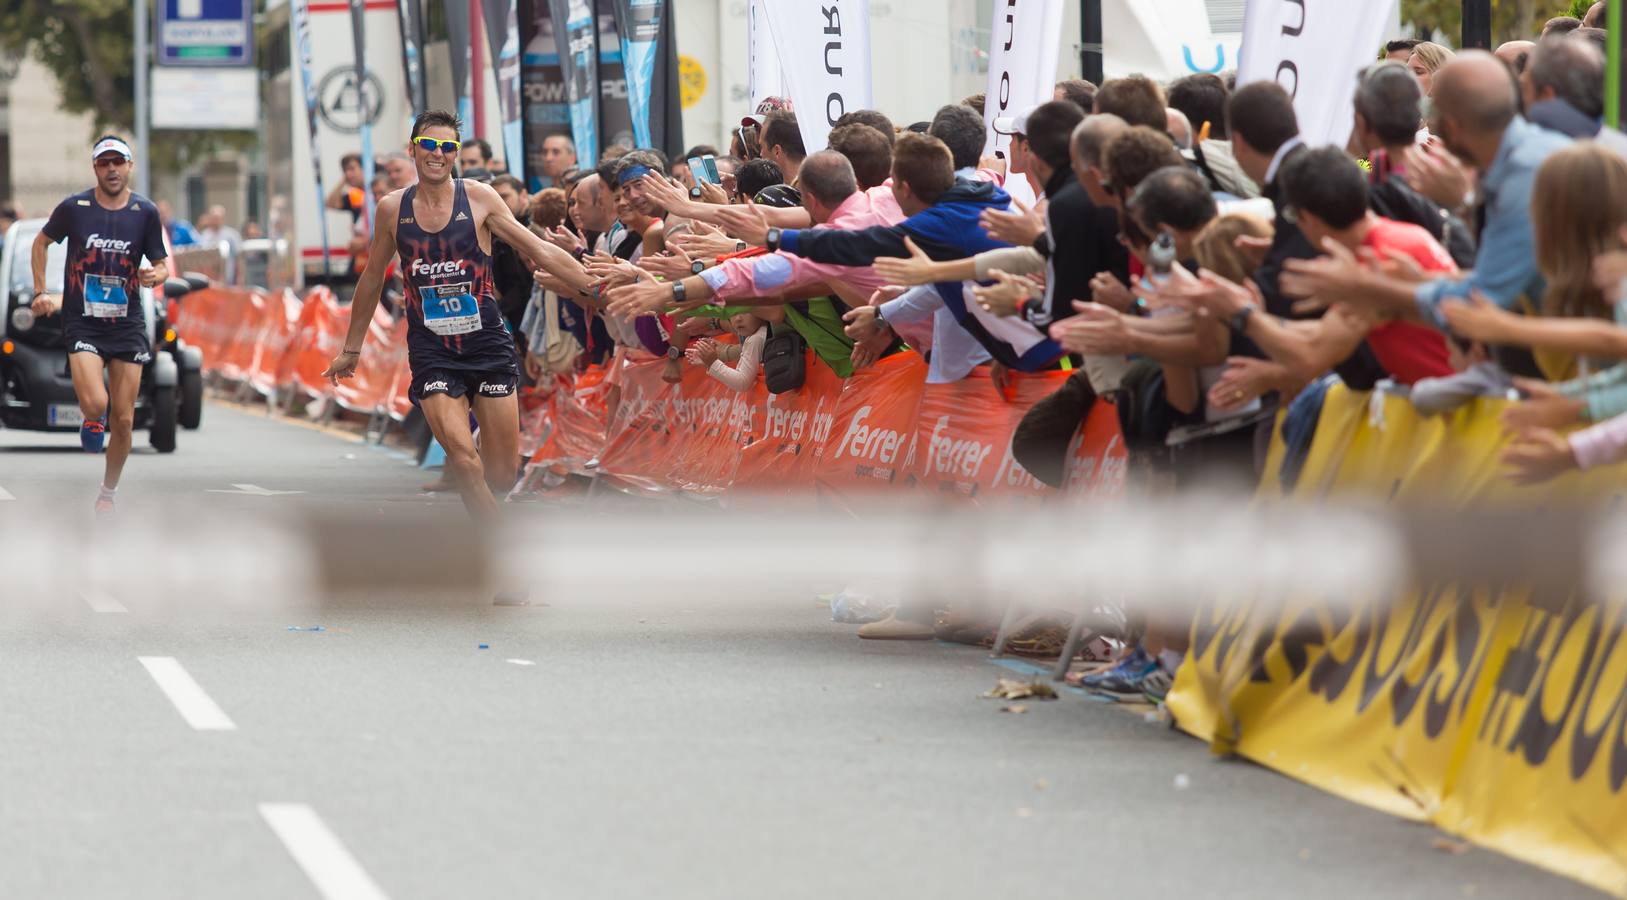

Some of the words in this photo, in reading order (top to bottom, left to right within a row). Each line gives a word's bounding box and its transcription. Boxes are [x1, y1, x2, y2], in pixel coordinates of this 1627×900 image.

[86, 233, 132, 249] Ferrer
[412, 258, 464, 276] Ferrer
[430, 271, 460, 280] sportcenter
[102, 287, 112, 300] 7
[438, 297, 462, 313] 10
[479, 381, 507, 393] Ferrer
[834, 405, 907, 464] Ferrer
[924, 415, 992, 477] Ferrer
